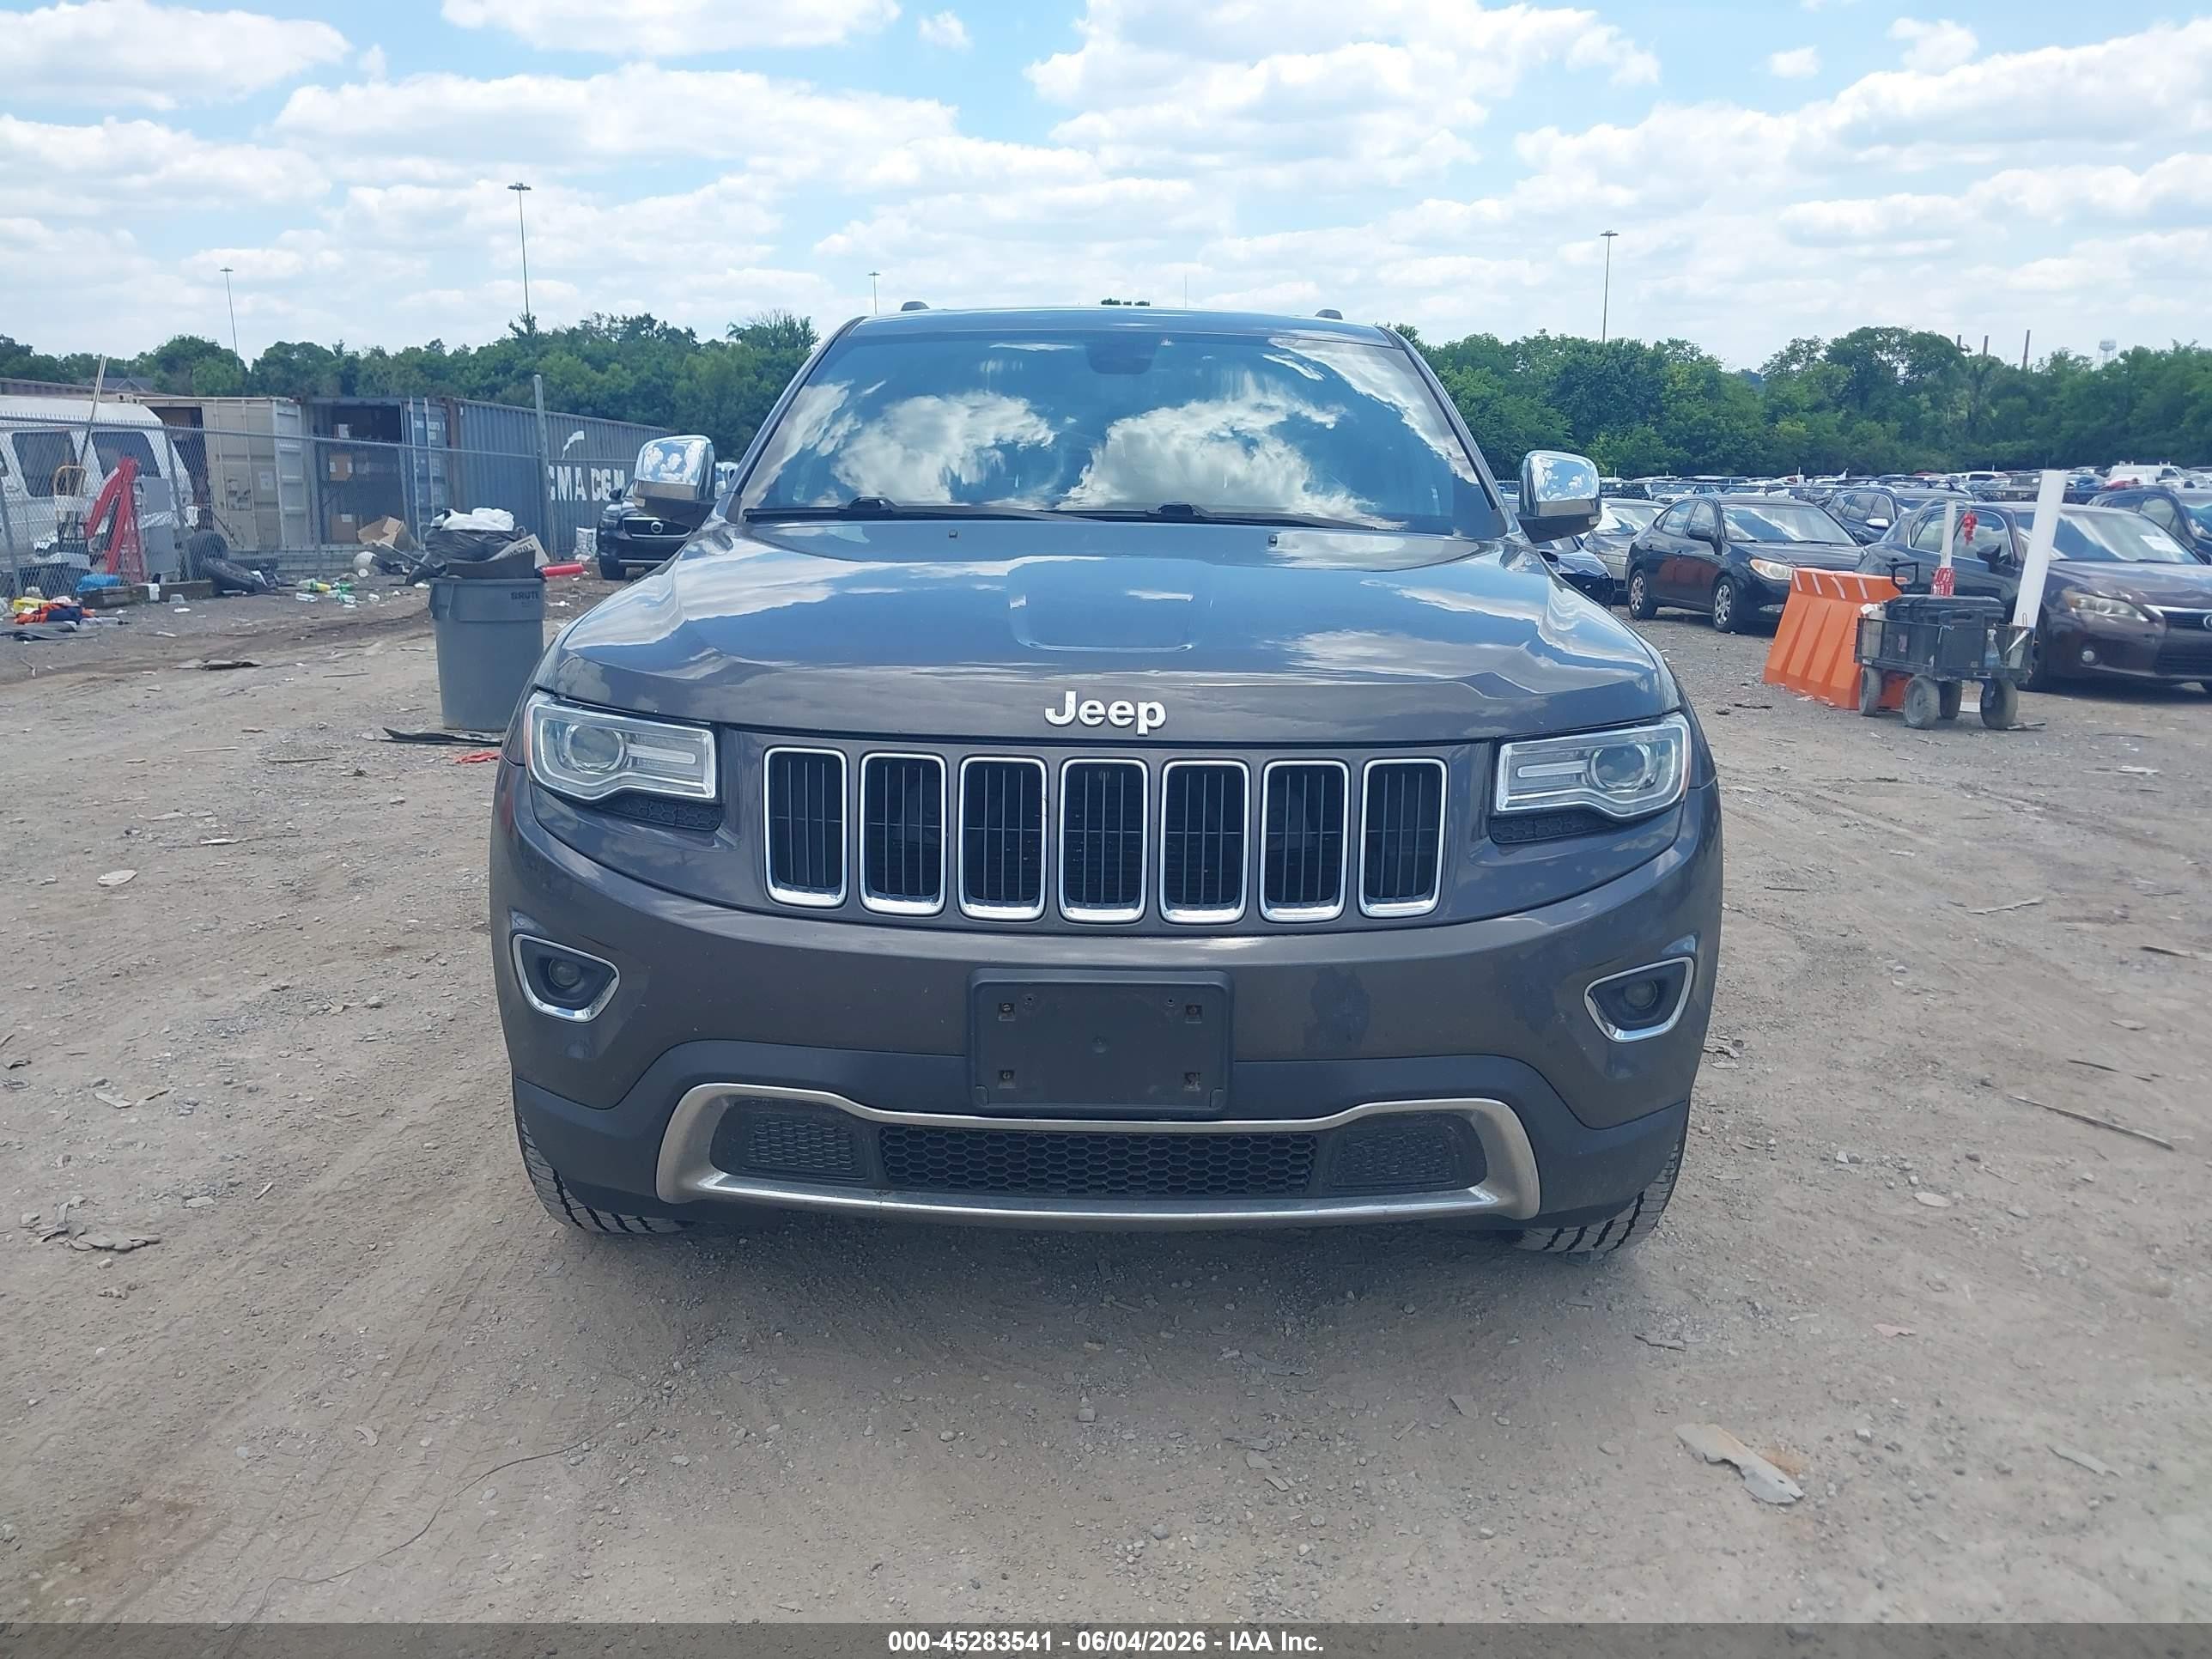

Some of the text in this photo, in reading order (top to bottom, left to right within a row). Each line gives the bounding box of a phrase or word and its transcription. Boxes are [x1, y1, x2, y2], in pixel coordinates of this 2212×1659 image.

[548, 465, 587, 501] CMA
[511, 591, 540, 600] BRUTE
[1044, 690, 1167, 737] Jeep
